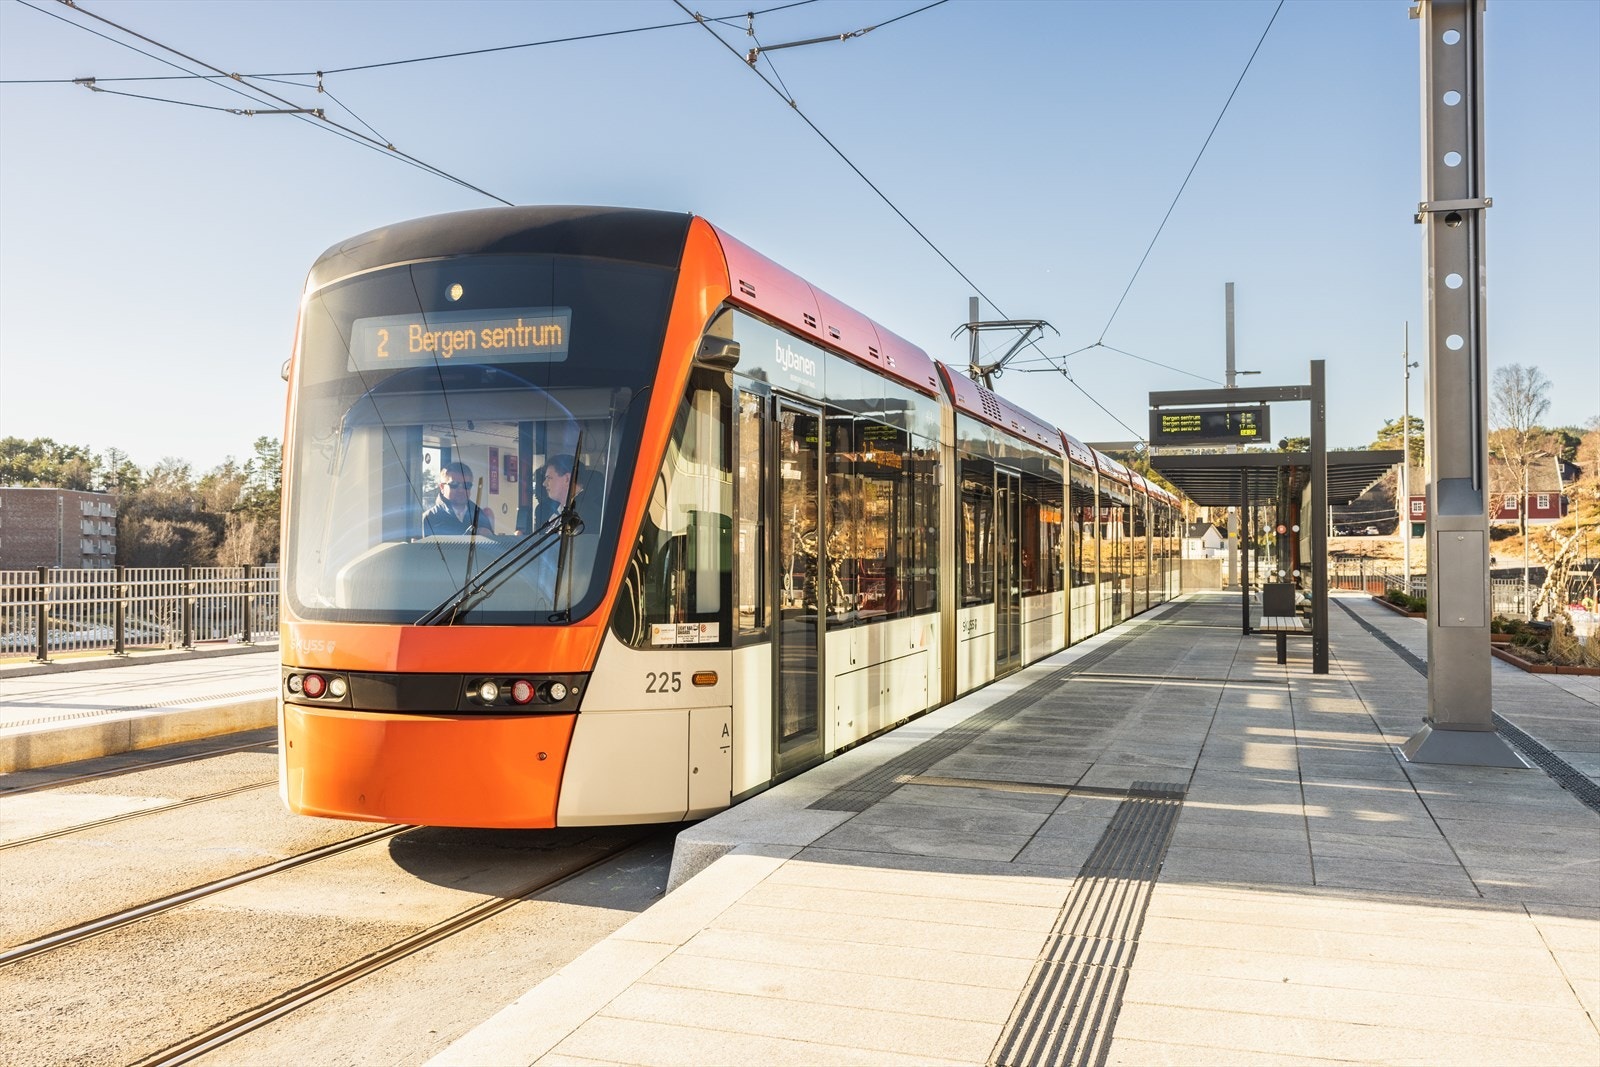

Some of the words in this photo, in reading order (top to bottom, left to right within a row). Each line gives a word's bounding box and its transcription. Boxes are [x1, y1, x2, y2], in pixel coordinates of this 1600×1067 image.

[376, 328, 389, 358] 2
[408, 323, 476, 358] Bergen
[480, 318, 562, 349] sentrum
[775, 338, 816, 377] bybanen
[289, 638, 326, 655] skyss
[645, 671, 682, 694] 225
[721, 722, 730, 738] A
